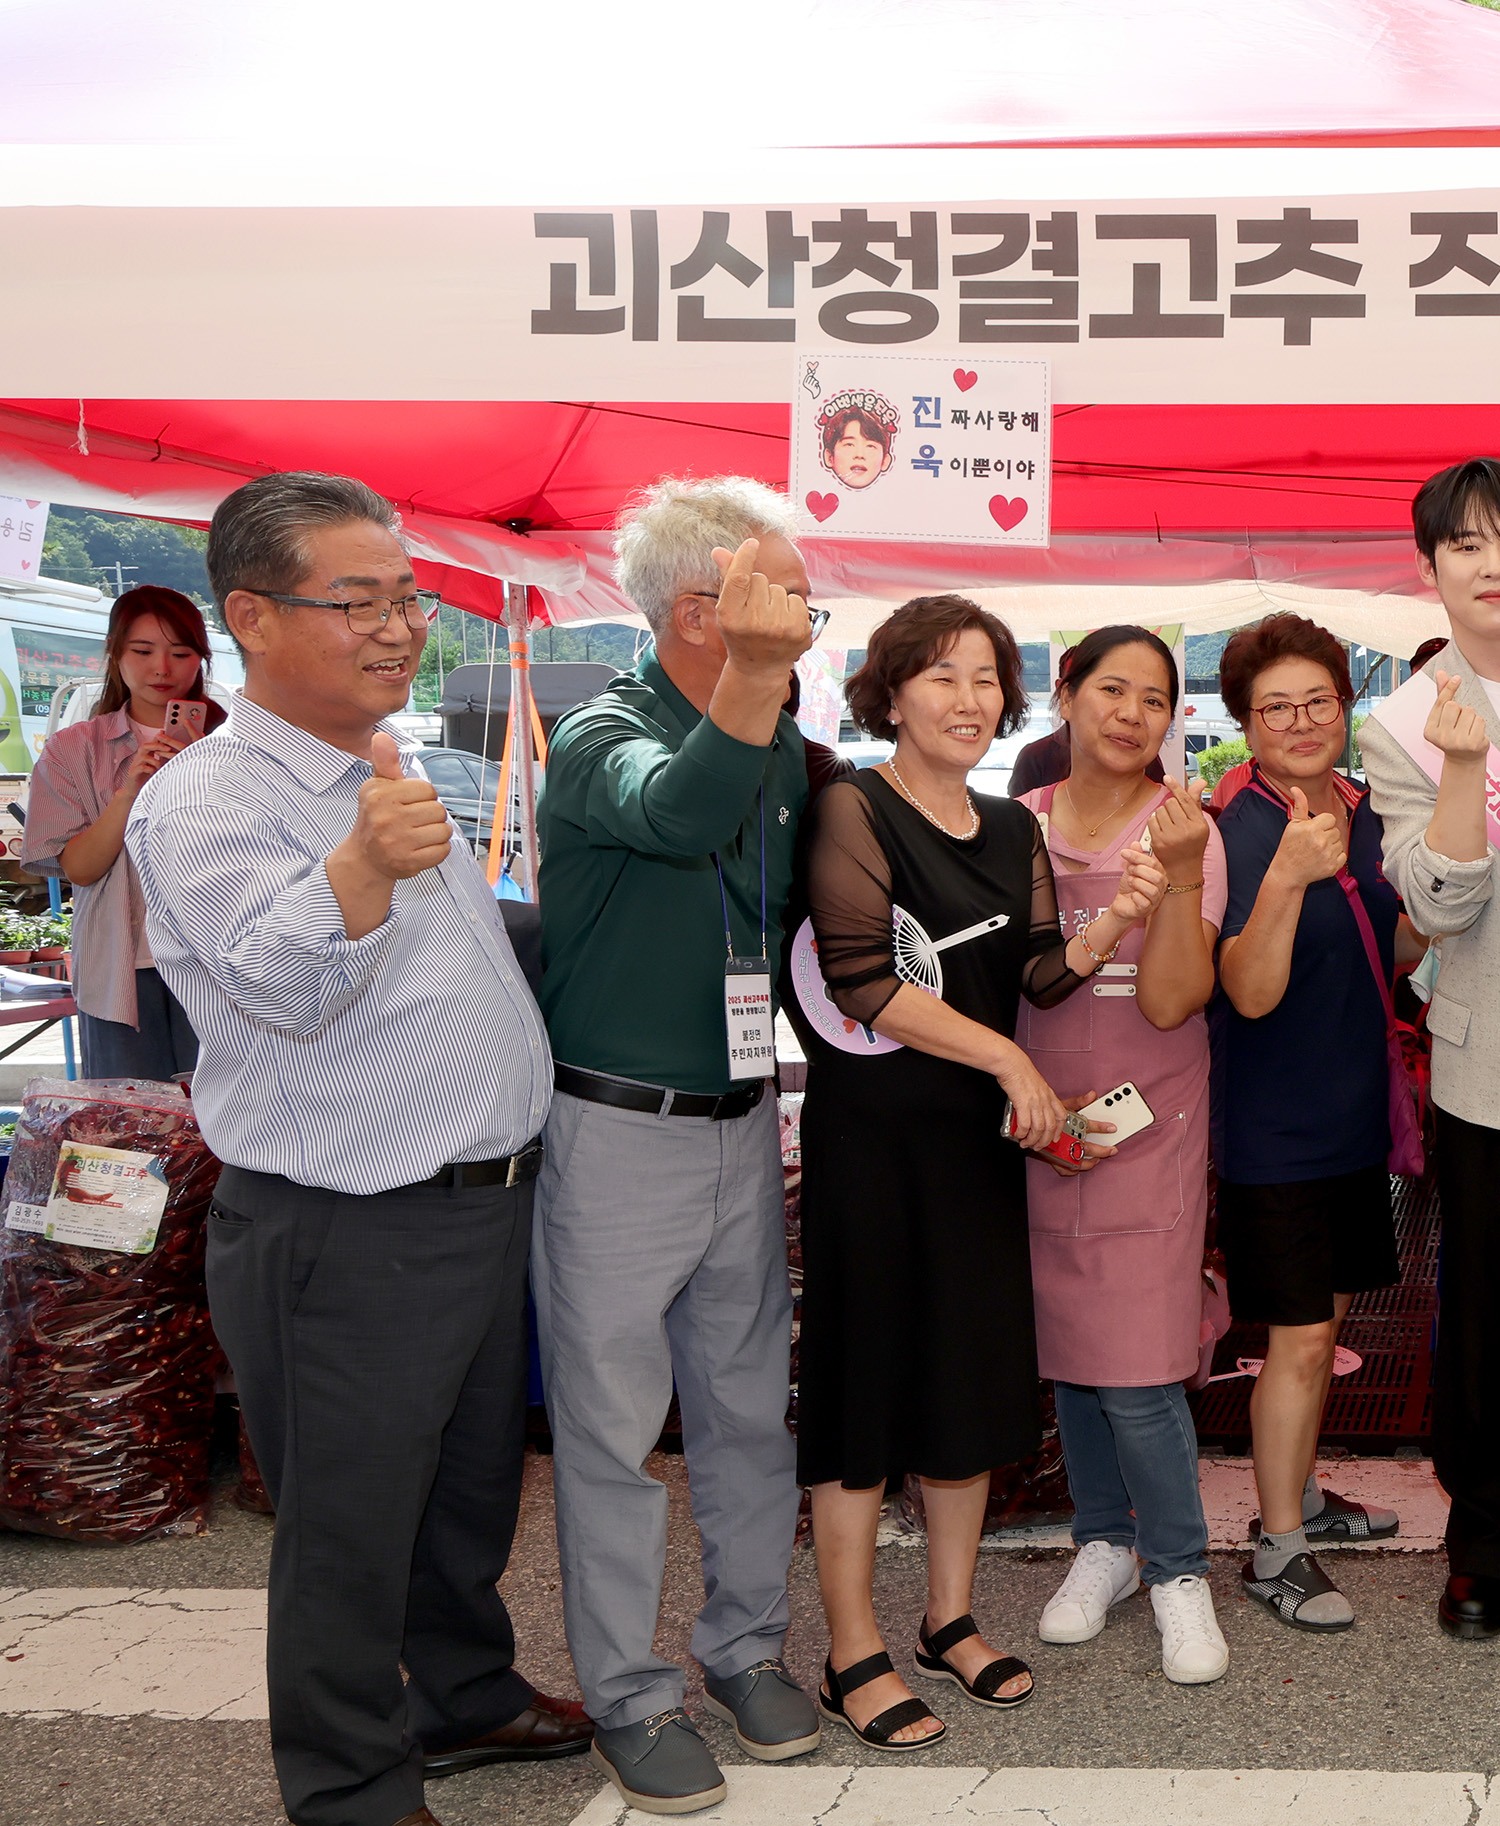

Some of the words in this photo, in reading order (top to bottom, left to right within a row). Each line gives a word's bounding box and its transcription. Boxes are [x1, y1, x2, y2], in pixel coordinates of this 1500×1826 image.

[531, 208, 1366, 346] 괴산청결고추
[912, 396, 942, 428] 진
[911, 444, 943, 478] 욱
[727, 996, 742, 1005] 2025
[742, 1029, 761, 1041] 불정면
[74, 1159, 149, 1180] 괴산청결고추
